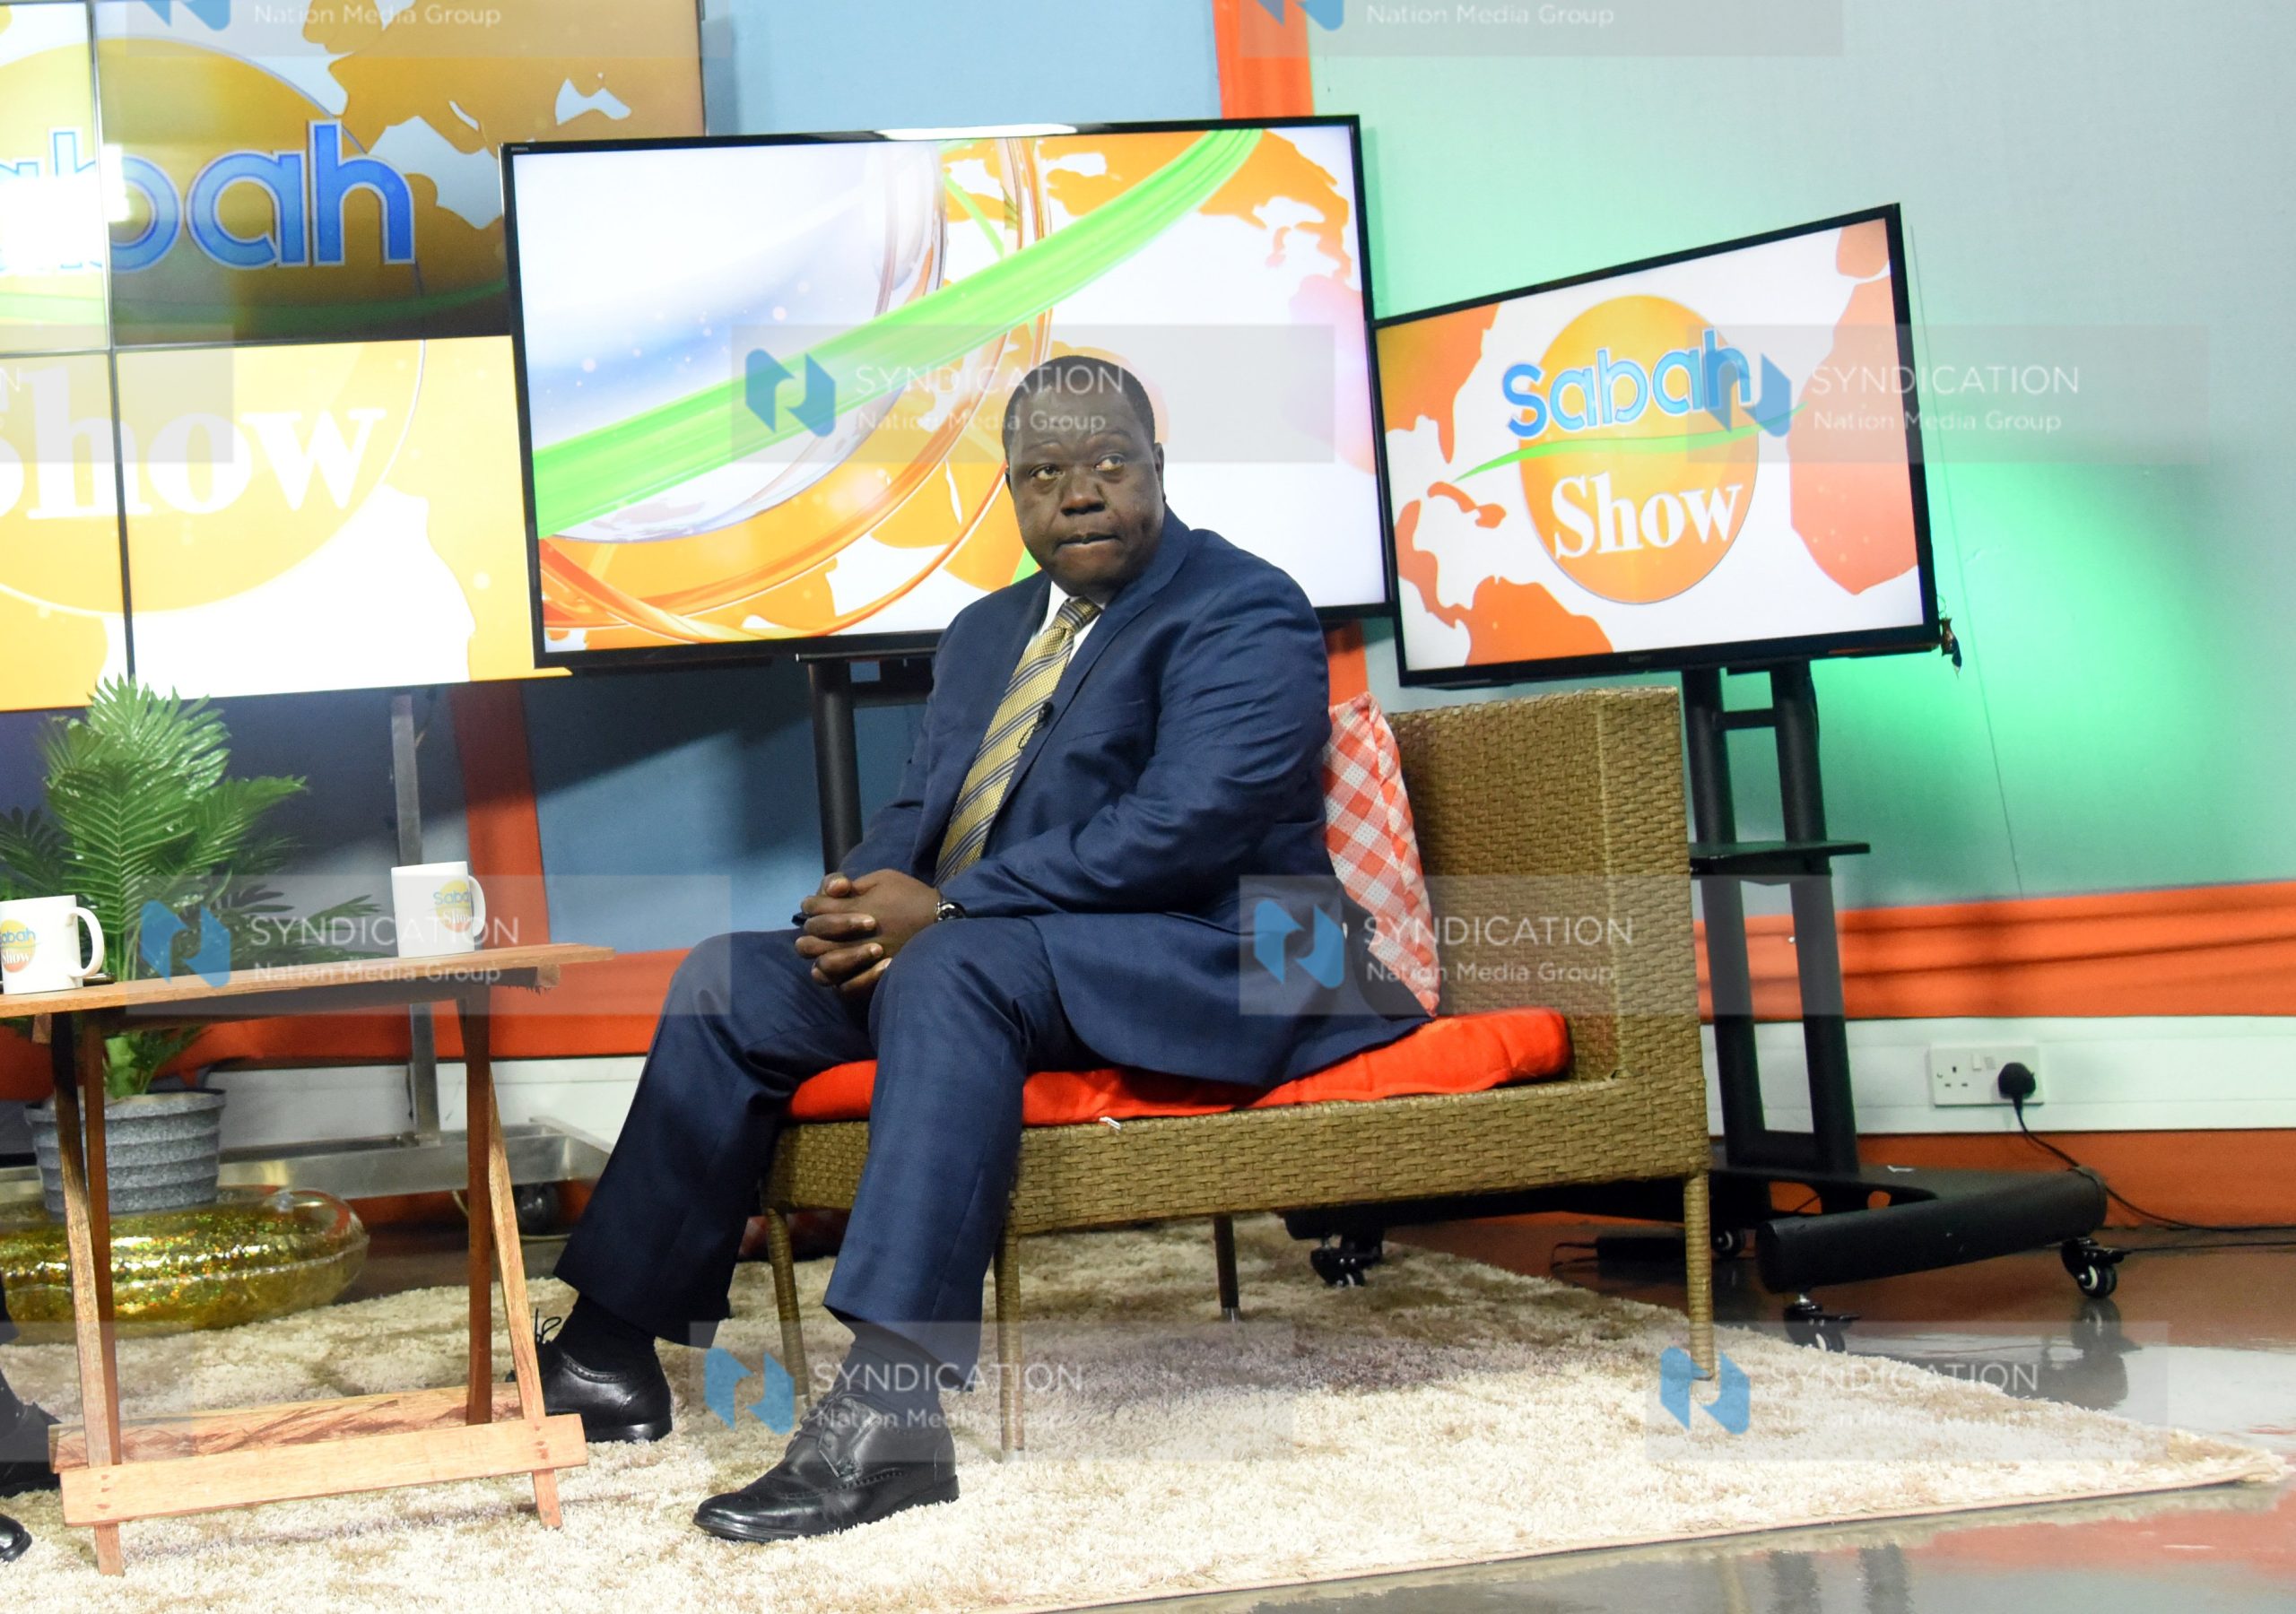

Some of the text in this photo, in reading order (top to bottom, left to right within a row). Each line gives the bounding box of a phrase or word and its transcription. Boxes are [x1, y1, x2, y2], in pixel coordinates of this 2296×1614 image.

[0, 119, 417, 272] bah
[0, 364, 387, 520] how
[1502, 328, 1752, 438] Sabah
[1550, 471, 1744, 560] Show
